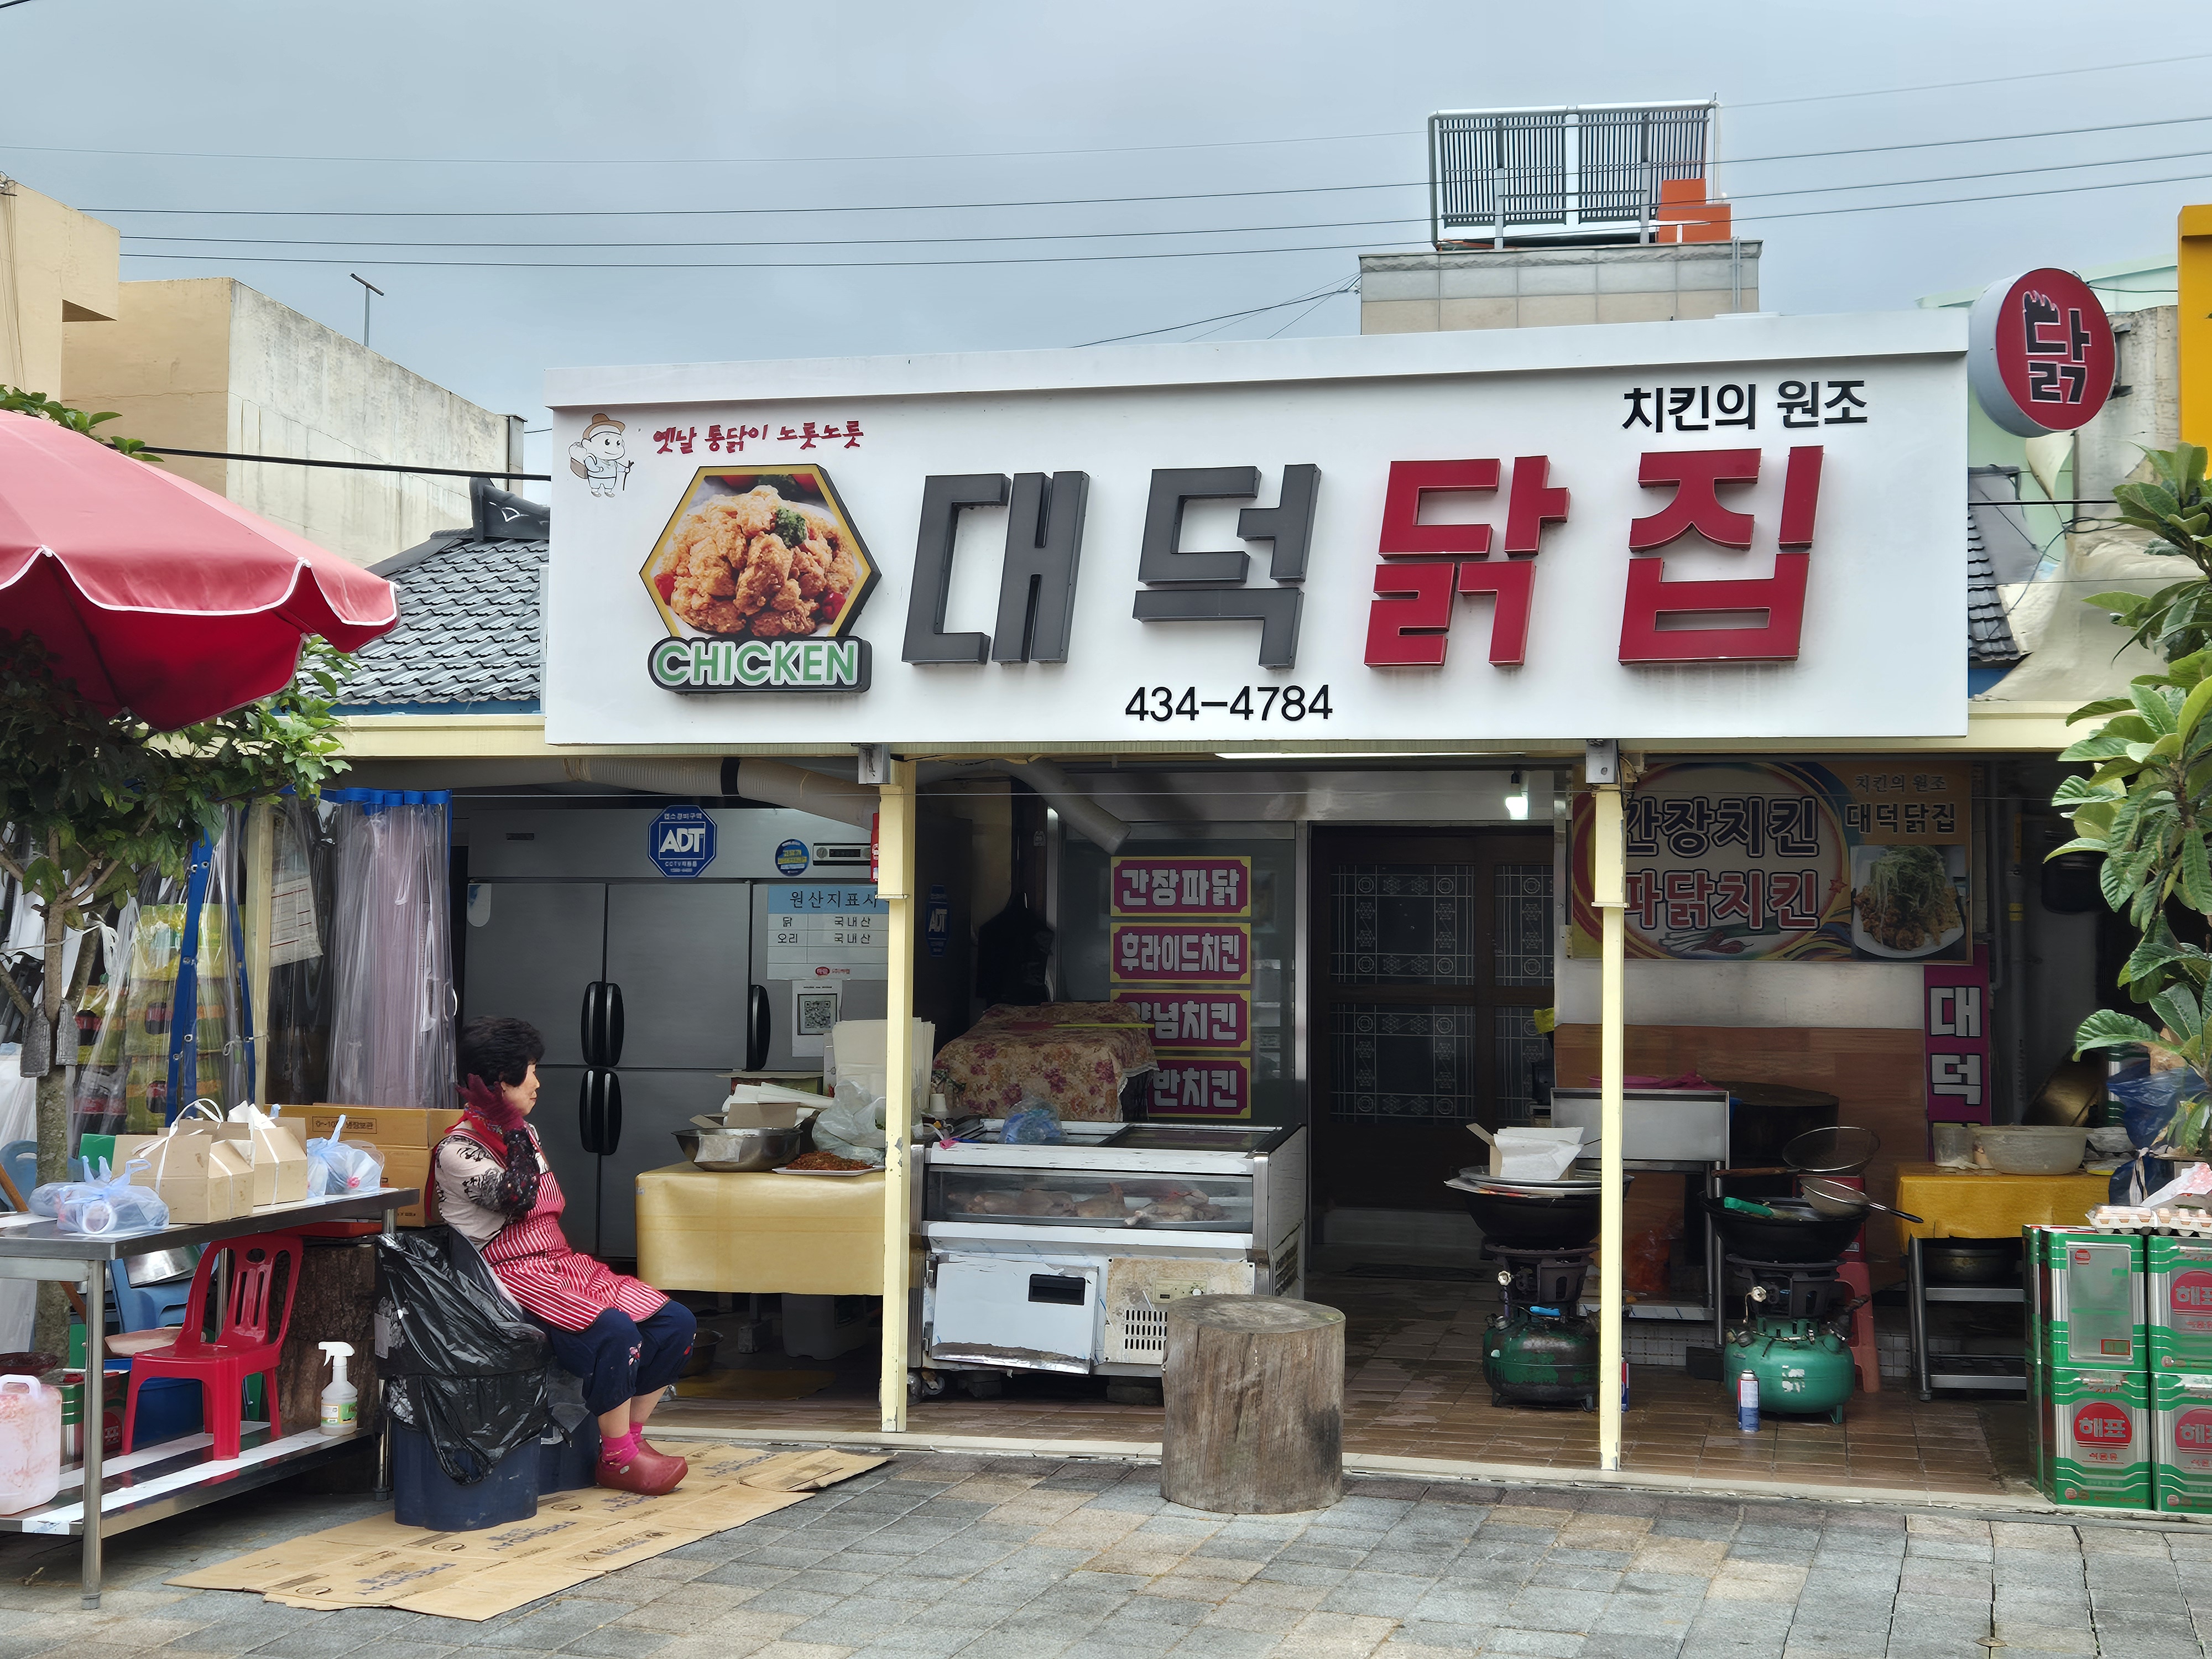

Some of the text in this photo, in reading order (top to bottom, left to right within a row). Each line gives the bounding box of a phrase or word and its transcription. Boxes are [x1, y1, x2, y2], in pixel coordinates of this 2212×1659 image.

[2022, 290, 2092, 405] 닭
[1621, 379, 1868, 434] 치킨의 원조
[653, 420, 864, 455] 옛날 통닭이 노릇노릇
[901, 445, 1825, 670] 대덕닭집
[654, 640, 858, 686] CHICKEN
[1125, 684, 1333, 723] 434-4784
[1855, 774, 1947, 794] 치킨의 원조
[1627, 795, 1820, 858] 간장치킨
[1845, 802, 1955, 834] 대덕닭집
[659, 828, 706, 852] ADT
[790, 890, 888, 908] 원산지표시
[1121, 868, 1240, 906] 간장파닭
[778, 933, 870, 944] 오리 국내산
[782, 916, 870, 927] 닭 국내산
[1121, 932, 1240, 972] 후라이드치킨
[1152, 1067, 1237, 1108] 반치킨
[2079, 1417, 2126, 1438] 해표
